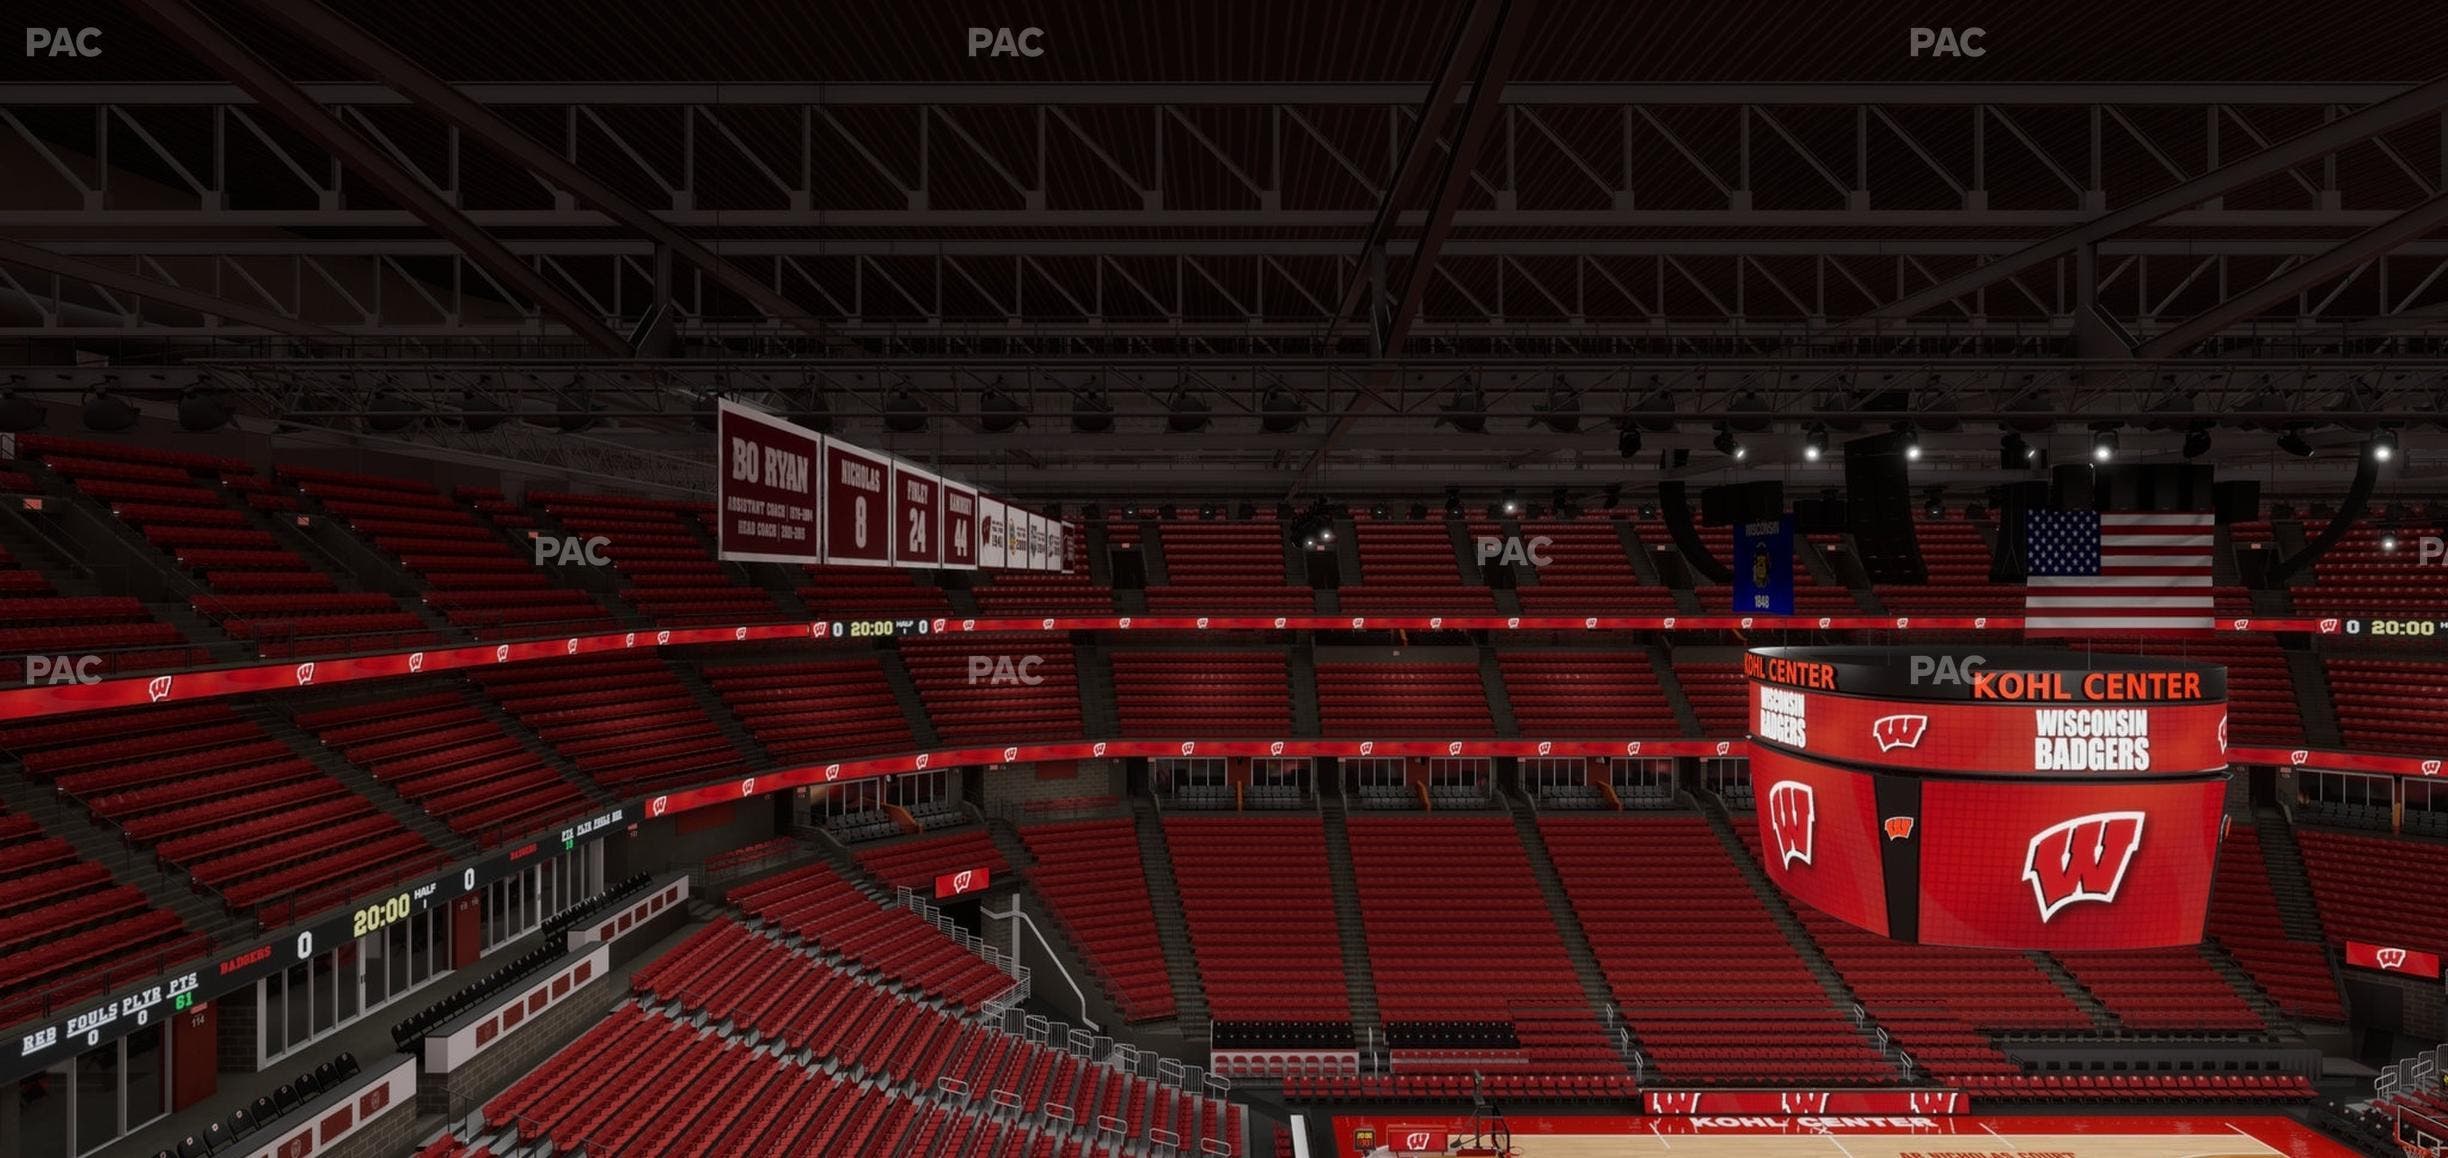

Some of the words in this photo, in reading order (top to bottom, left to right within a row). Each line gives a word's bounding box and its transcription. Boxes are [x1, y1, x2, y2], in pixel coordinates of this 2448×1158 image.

[732, 436, 759, 483] BO
[764, 446, 808, 495] RYAN
[841, 458, 880, 493] NICHOLAS
[728, 496, 765, 515] ASSISTANT
[766, 502, 786, 519] COACH
[855, 495, 867, 549] 8
[738, 520, 755, 536] HEAD
[757, 521, 777, 538] COACH
[909, 507, 926, 553] 24
[953, 518, 968, 557] 44
[832, 622, 844, 637] 0
[850, 620, 894, 637] 20:00
[919, 619, 928, 634] 0
[2346, 620, 2360, 634] 0
[2371, 620, 2435, 636] 20:00
[1768, 656, 1836, 690] CENTER
[1972, 671, 2072, 700] KOHL
[2082, 671, 2202, 700] CENTER
[1760, 709, 1806, 749] BADGERS
[2035, 708, 2148, 736] WISCONSIN
[2034, 737, 2150, 771] BADGERS
[414, 882, 437, 900] HALF
[464, 867, 475, 891] 0
[353, 891, 410, 938] 20:00
[297, 930, 313, 960] 0
[219, 945, 272, 976] BADGERS
[23, 1026, 57, 1056] REB
[67, 1002, 118, 1038] FOULS
[122, 986, 162, 1016] PLYR
[167, 972, 199, 998] PTS
[137, 1009, 148, 1026] 0
[87, 1029, 100, 1046] 0
[1689, 1116, 1788, 1128] KOHL
[1797, 1116, 1939, 1129] CENTER
